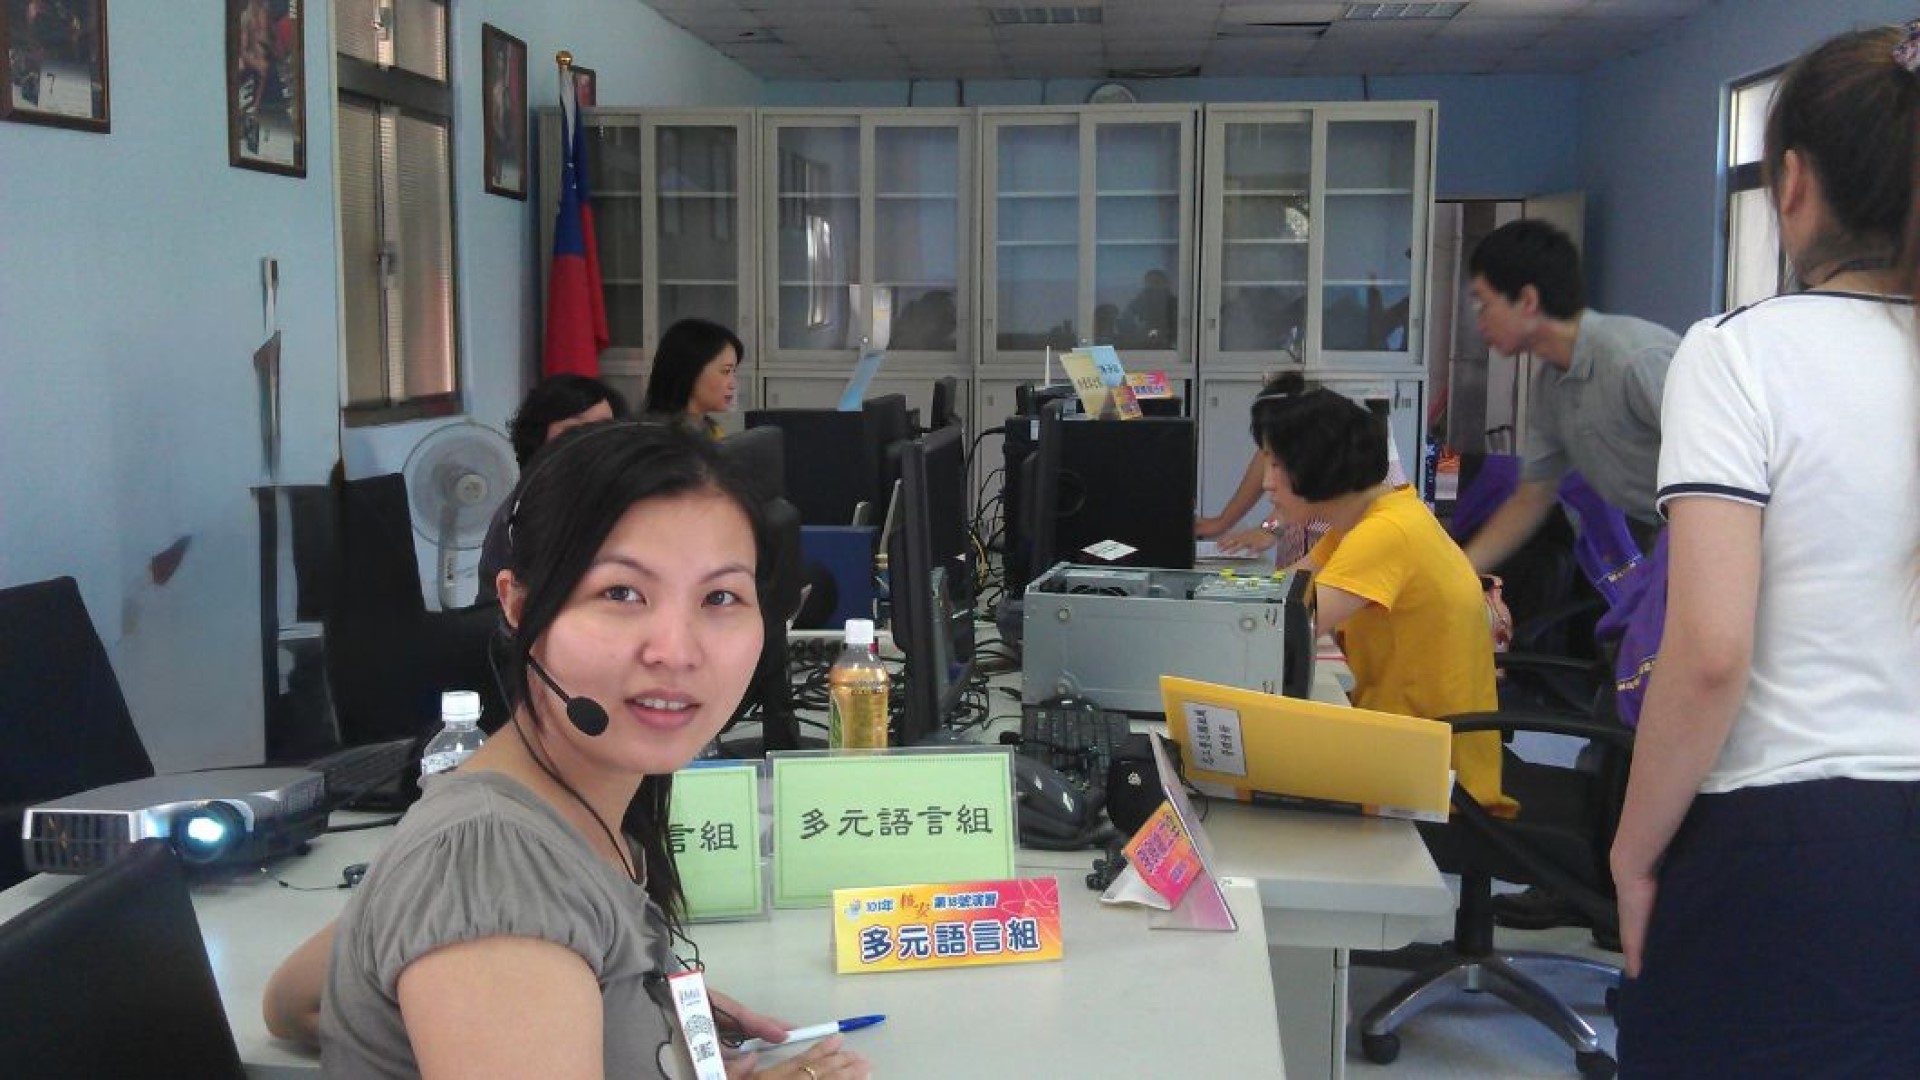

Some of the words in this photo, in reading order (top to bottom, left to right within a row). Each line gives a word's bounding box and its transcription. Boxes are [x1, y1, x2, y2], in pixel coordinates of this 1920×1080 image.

[47, 71, 56, 96] 7
[799, 804, 993, 840] 多元語言組
[861, 917, 1040, 962] 多元語言組
